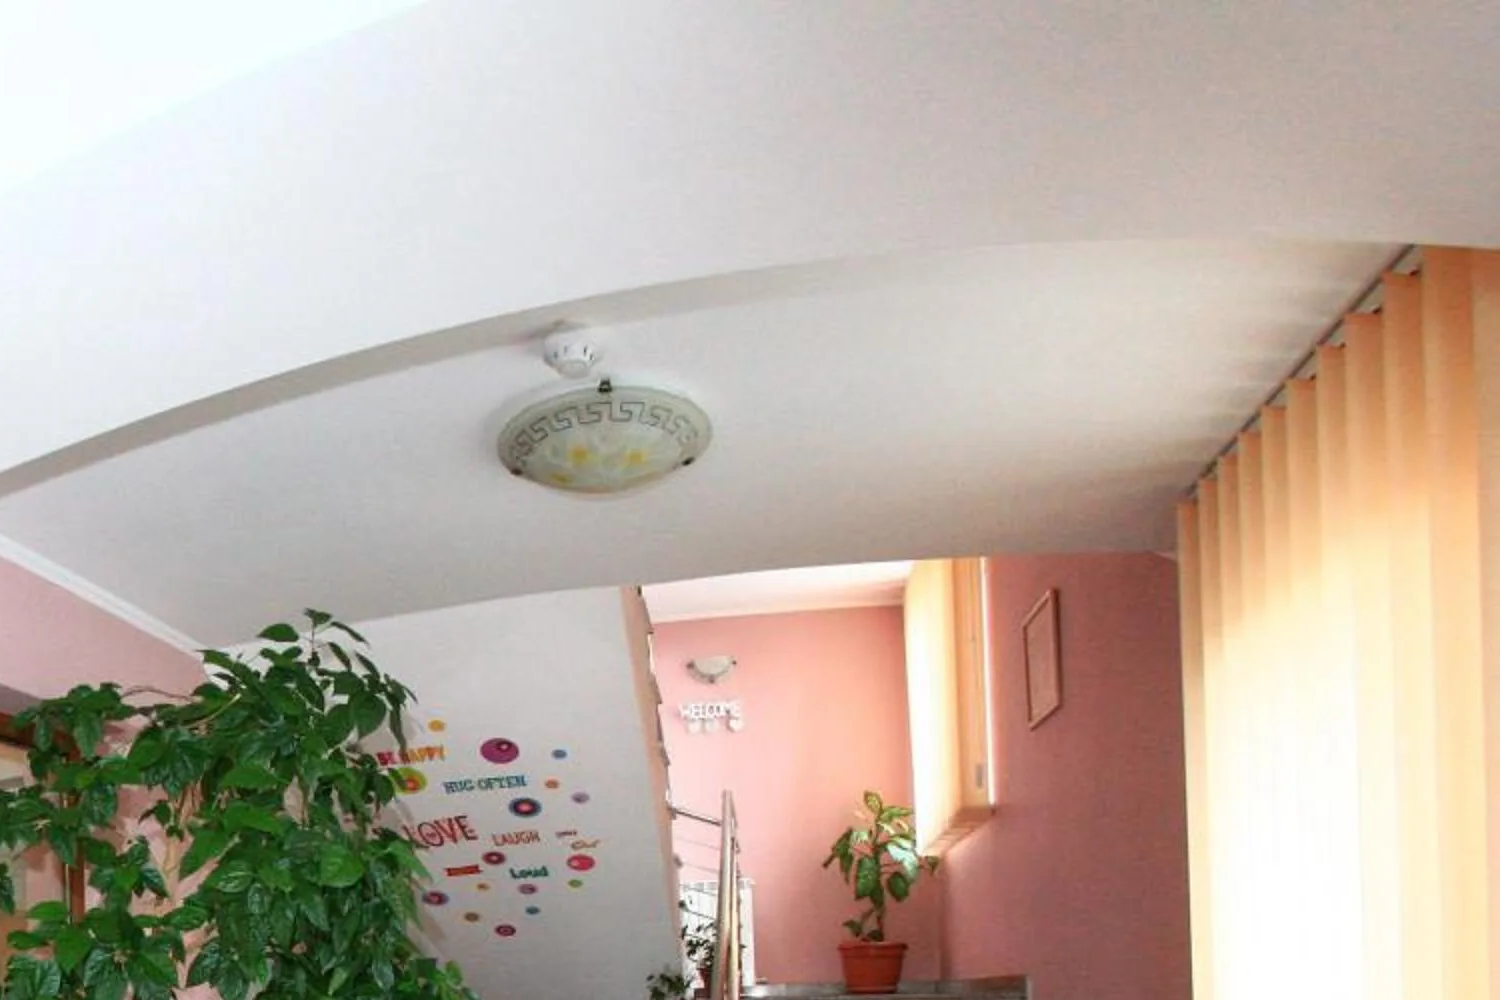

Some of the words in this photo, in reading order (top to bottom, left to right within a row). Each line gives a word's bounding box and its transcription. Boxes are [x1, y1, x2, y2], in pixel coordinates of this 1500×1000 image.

[478, 775, 527, 790] OFTEN
[401, 815, 478, 849] LOVE
[492, 831, 540, 846] LAUGH
